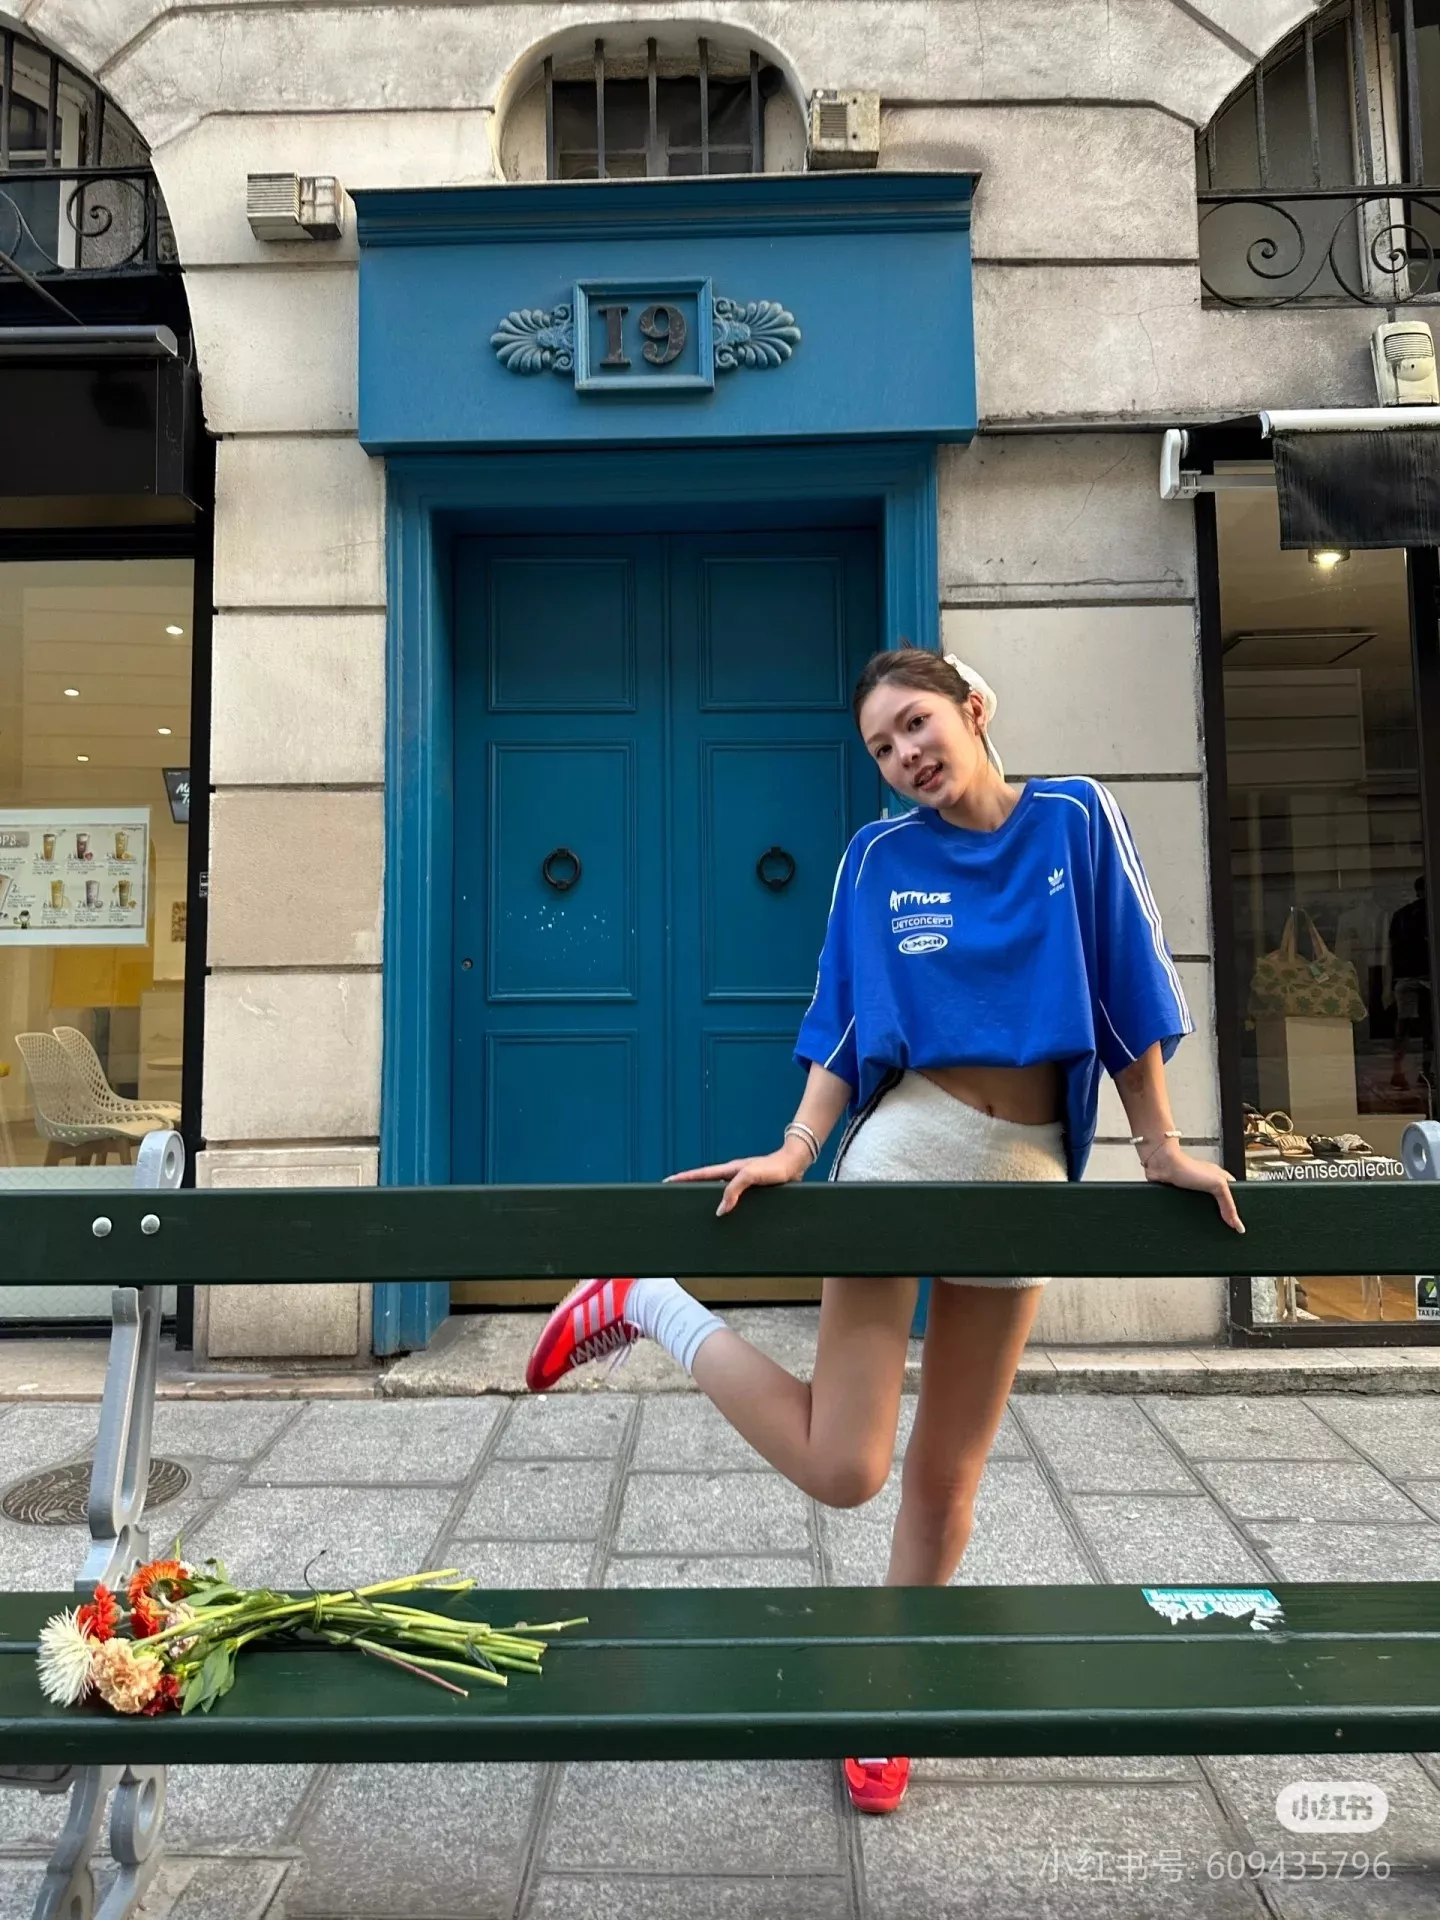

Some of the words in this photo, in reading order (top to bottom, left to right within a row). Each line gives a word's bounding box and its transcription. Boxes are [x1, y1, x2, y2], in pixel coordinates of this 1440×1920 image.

[597, 303, 687, 367] 19
[893, 916, 951, 930] JETCONCEPT
[1418, 1308, 1430, 1317] TAX
